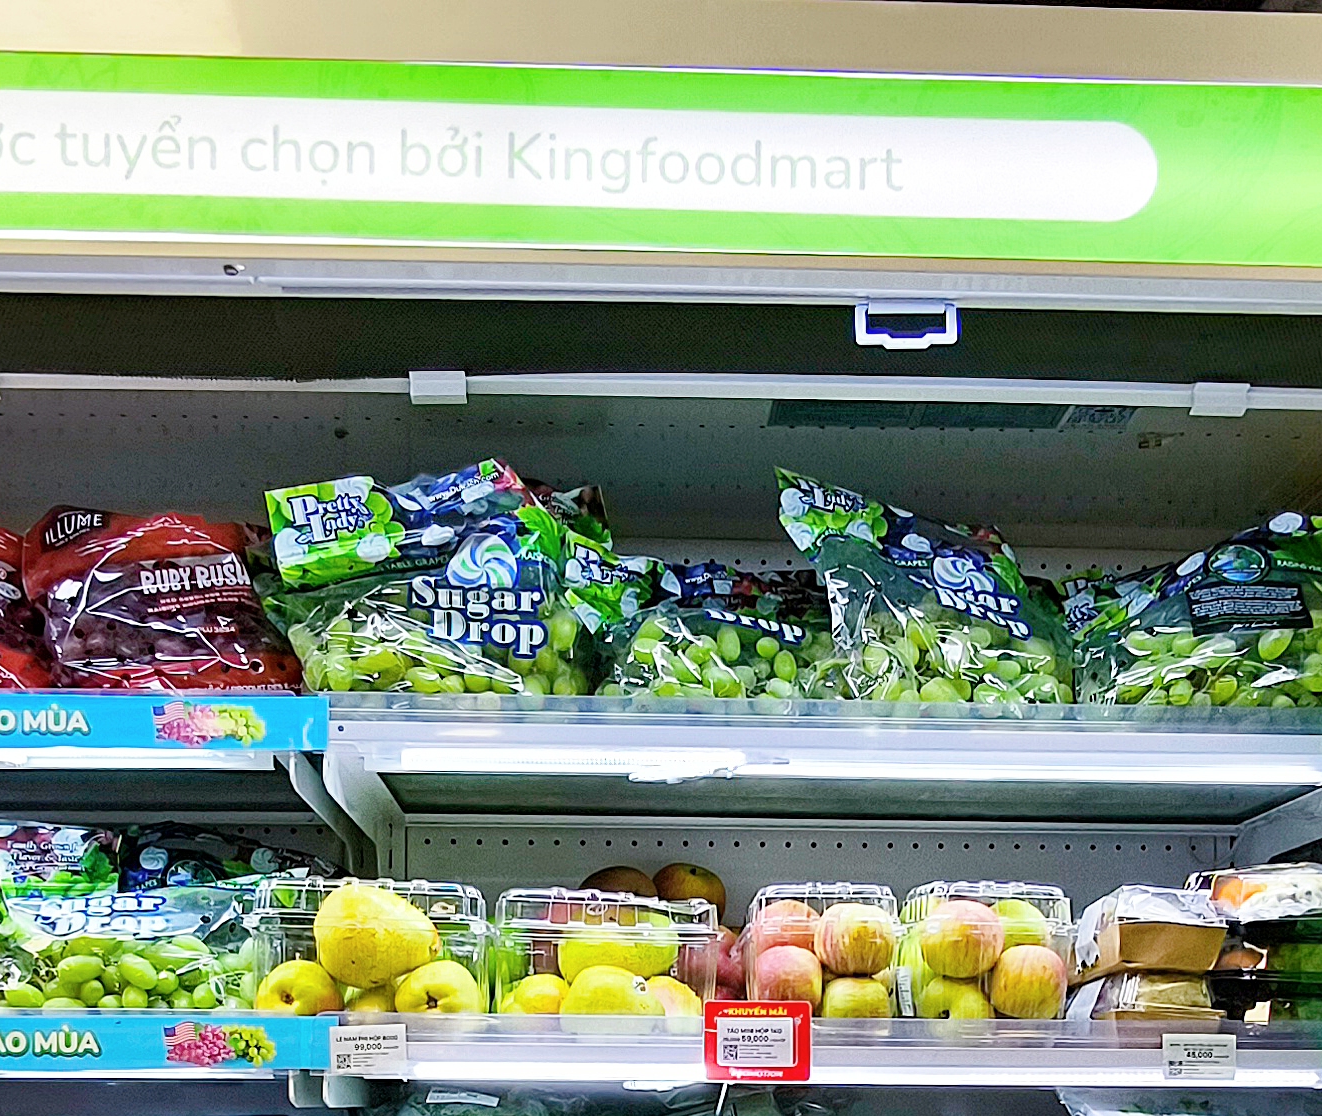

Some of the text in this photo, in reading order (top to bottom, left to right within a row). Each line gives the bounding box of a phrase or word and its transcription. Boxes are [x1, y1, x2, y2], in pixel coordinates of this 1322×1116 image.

[55, 115, 218, 180] tuyển
[240, 124, 376, 187] chọn
[399, 125, 483, 179] bởi
[507, 131, 904, 194] Kingfoodmart
[289, 493, 367, 522] Pretty
[46, 513, 104, 546] ILLUME
[140, 570, 193, 596] RUBY
[411, 577, 542, 618] Sugar
[430, 610, 546, 657] Drop
[21, 705, 90, 734] MÙA
[727, 1006, 767, 1017] KHUYẾN
[34, 1023, 101, 1057] MÙA
[354, 1043, 383, 1053] 99,000
[741, 1034, 769, 1044] 59,000
